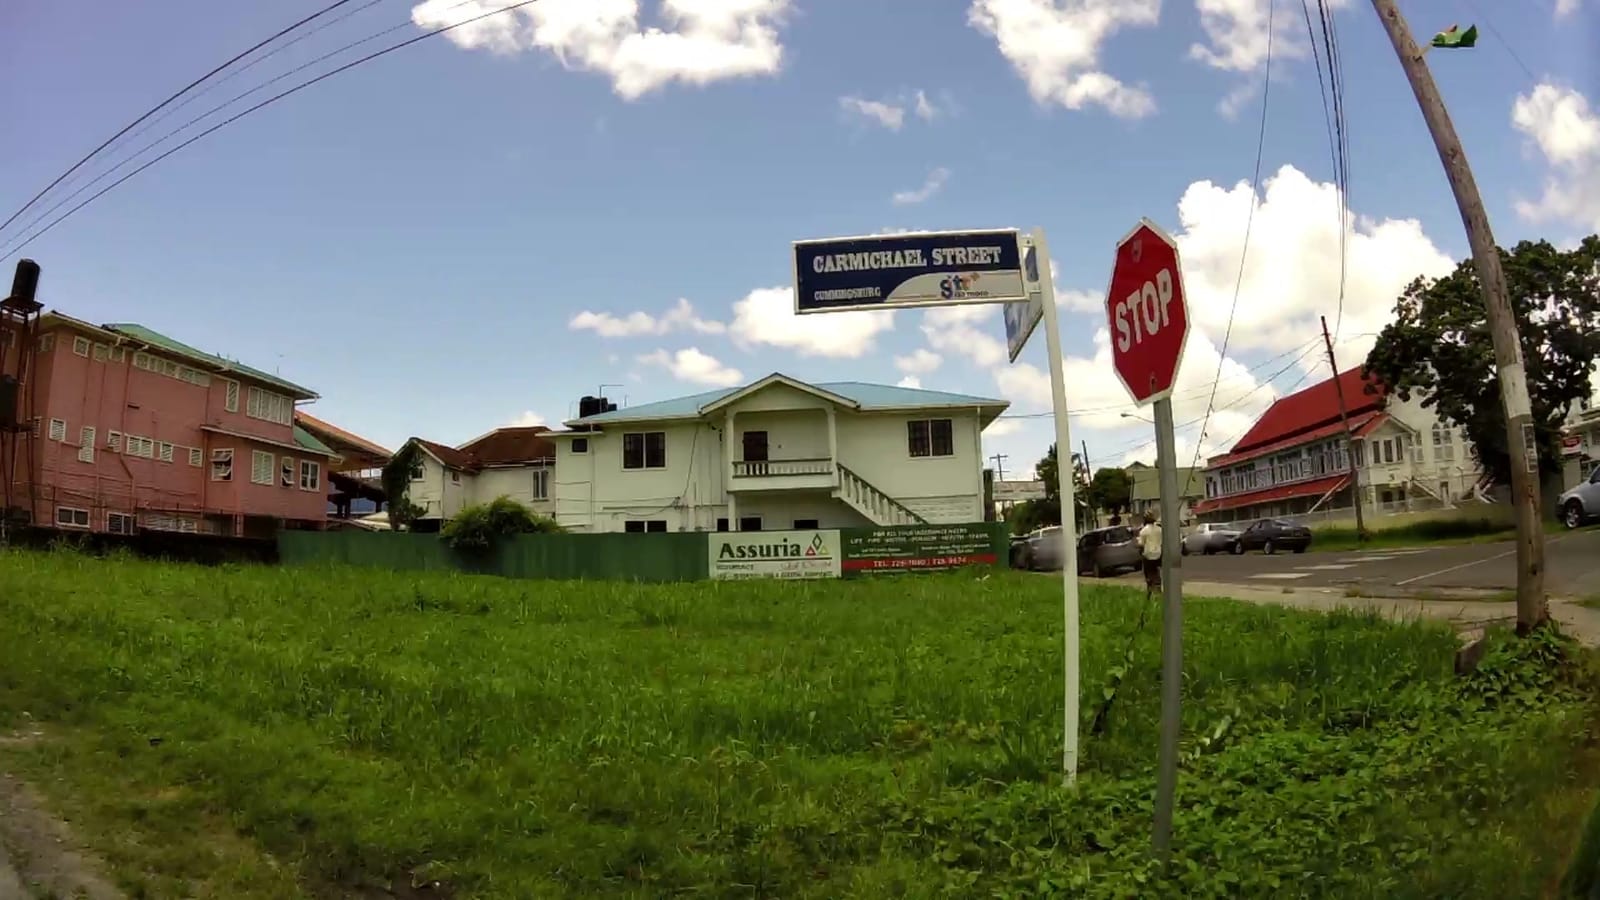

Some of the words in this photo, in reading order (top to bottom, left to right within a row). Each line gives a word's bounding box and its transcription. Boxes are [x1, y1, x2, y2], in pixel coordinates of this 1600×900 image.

[813, 249, 927, 273] CARMICHAEL
[932, 246, 1001, 266] STREET
[1115, 268, 1173, 353] STOP
[720, 538, 801, 559] Assuria
